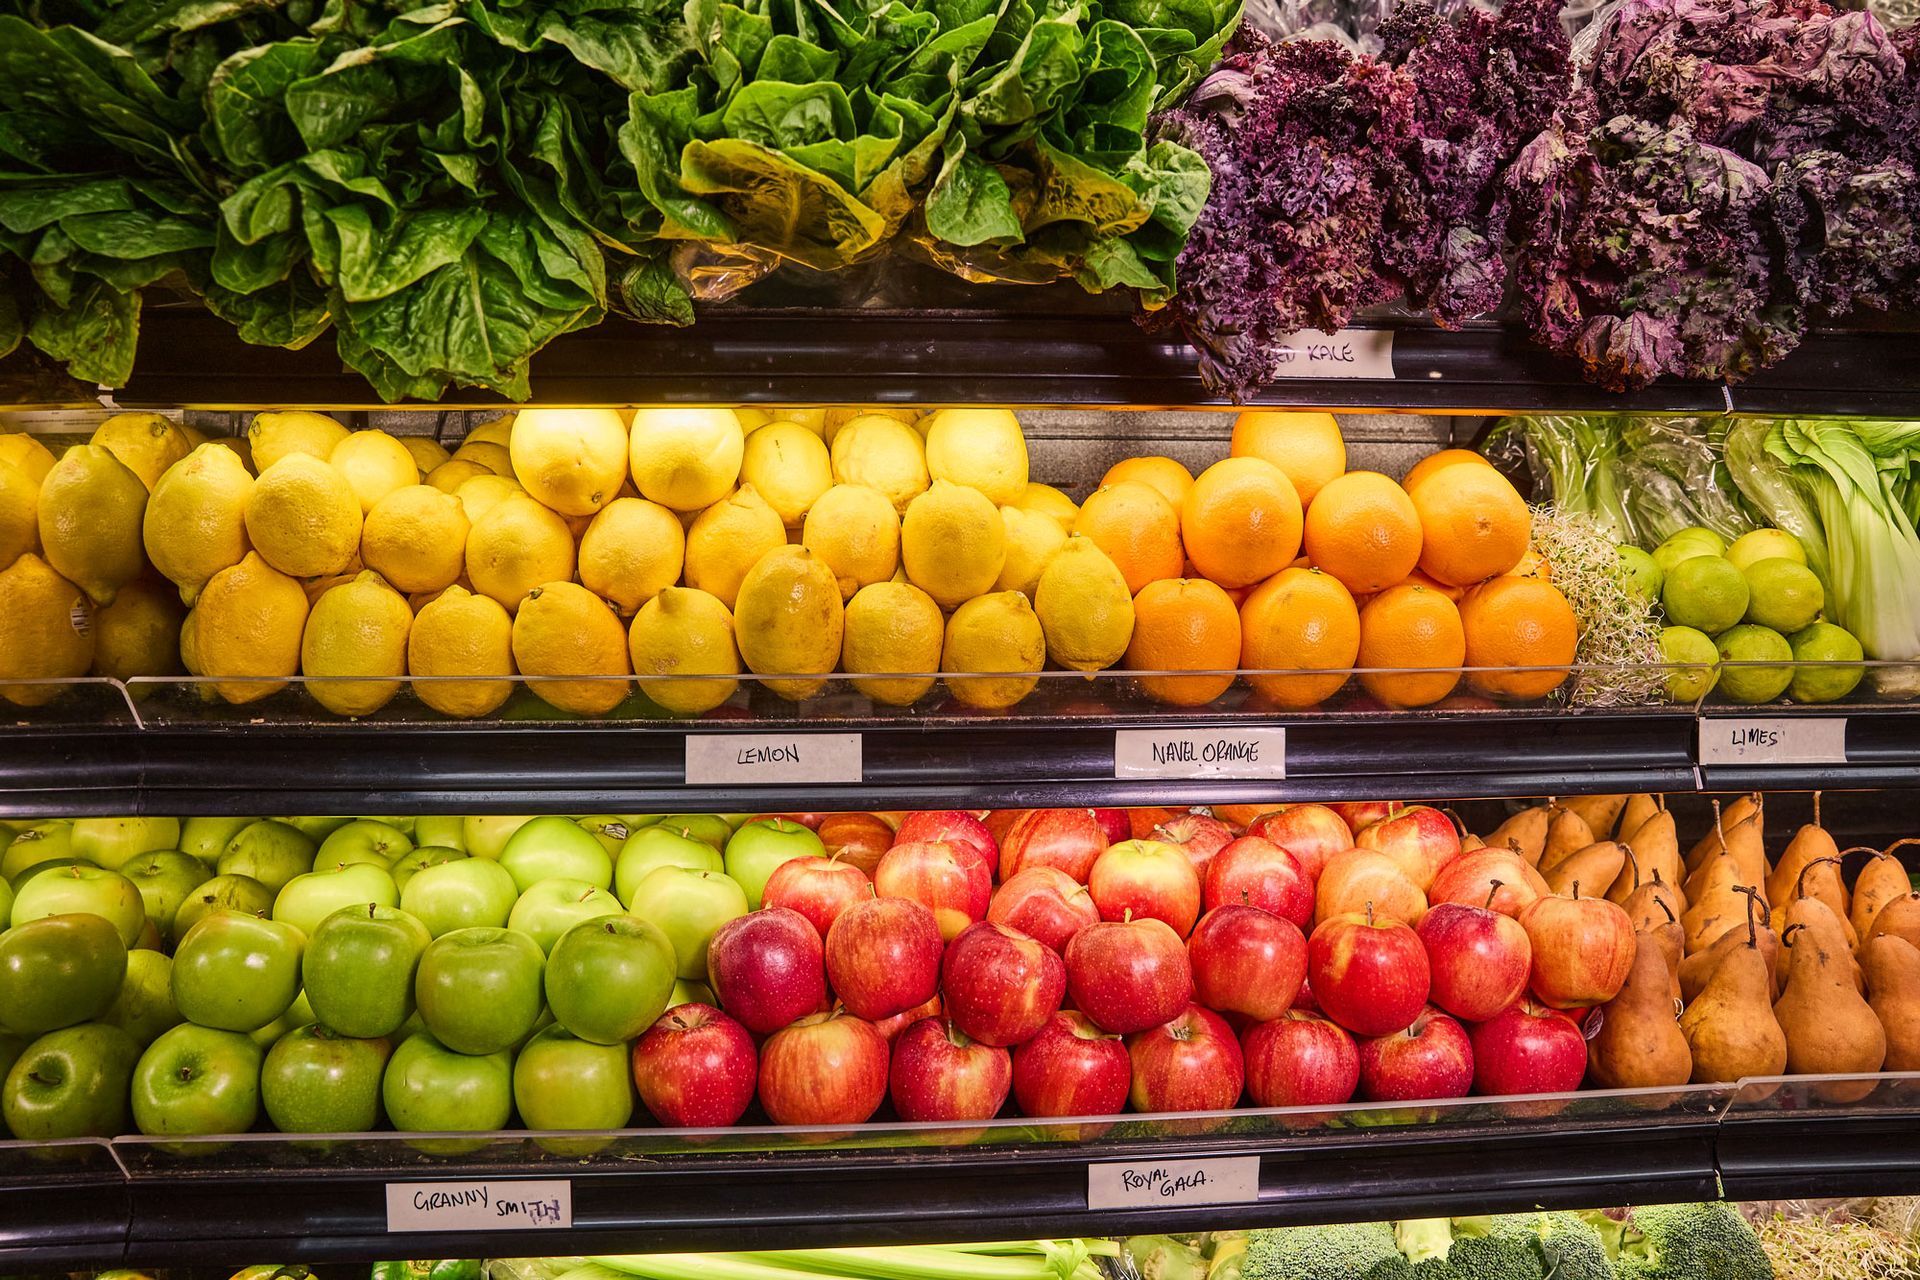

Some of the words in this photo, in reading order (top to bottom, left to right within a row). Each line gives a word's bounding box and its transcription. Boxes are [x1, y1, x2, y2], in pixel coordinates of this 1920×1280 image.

[1307, 342, 1355, 362] KALE
[1732, 728, 1779, 747] LIMES
[737, 743, 800, 765] LEMON
[1152, 740, 1198, 765] NAVEL
[1202, 740, 1260, 763] ORANGE
[1121, 1169, 1169, 1192] ROYAL
[413, 1186, 489, 1211] GRANNY
[496, 1199, 561, 1221] SMITH
